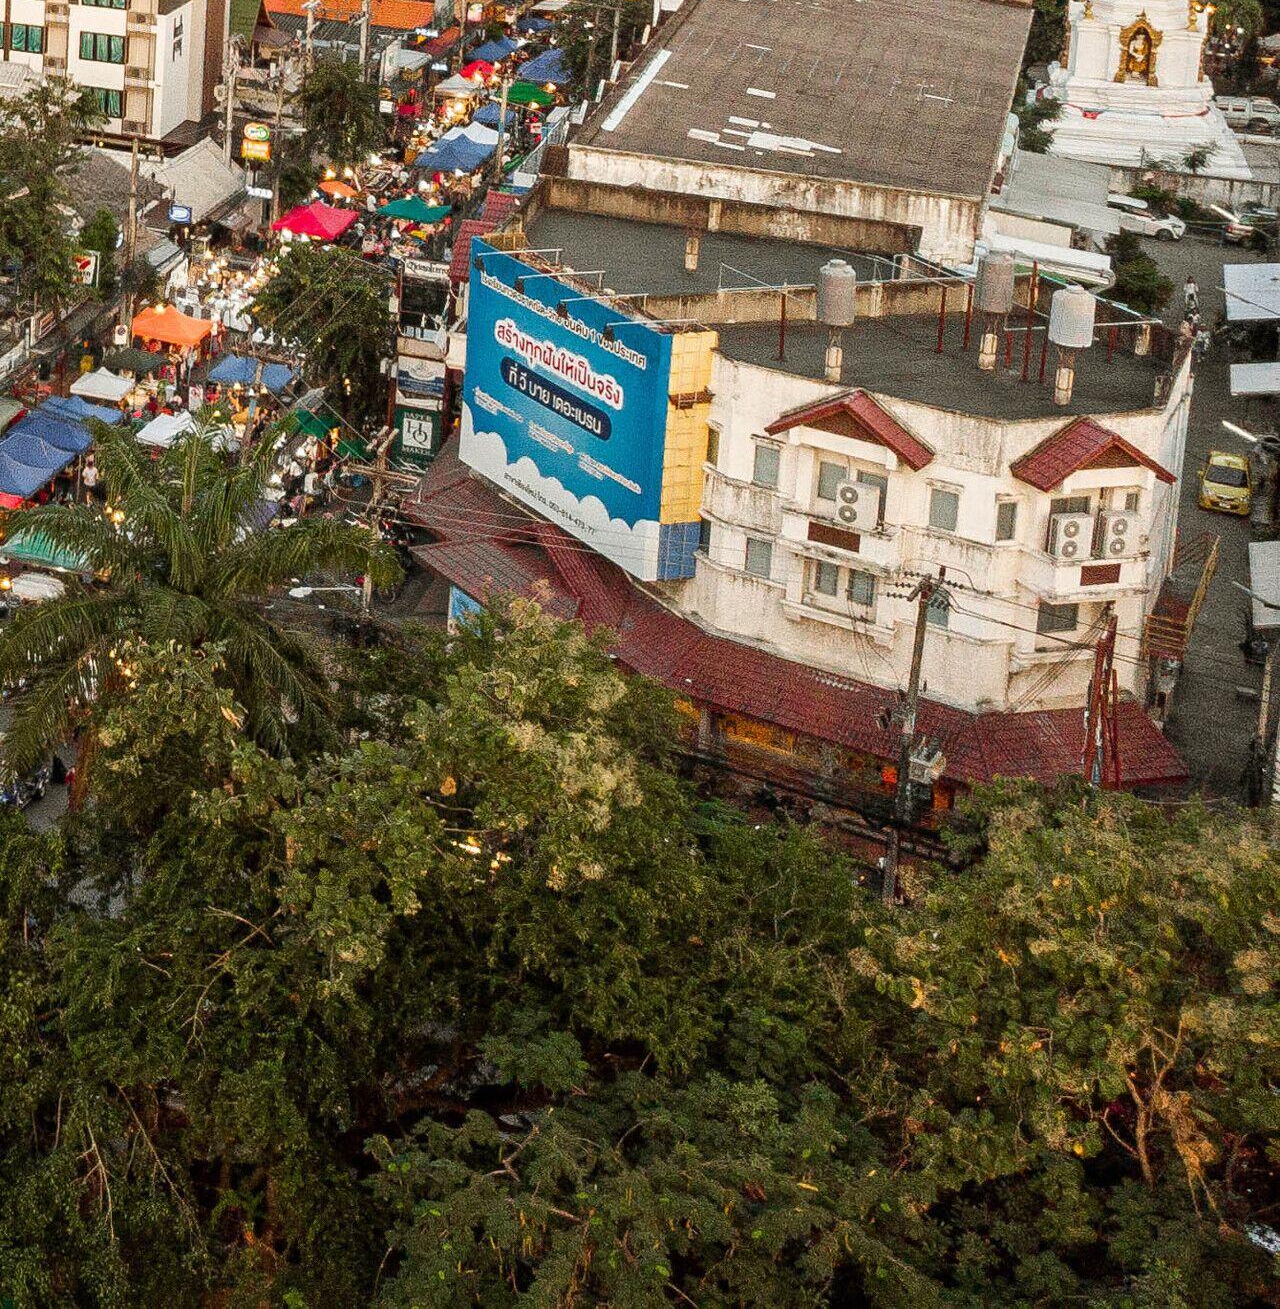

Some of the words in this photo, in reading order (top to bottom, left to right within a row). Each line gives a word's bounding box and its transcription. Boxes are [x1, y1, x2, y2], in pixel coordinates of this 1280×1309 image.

[496, 323, 621, 405] สร้างทุกฝันให้เป็นจริง
[589, 327, 595, 343] 1
[508, 362, 518, 387] ที่
[519, 371, 526, 391] วี
[529, 382, 549, 406] บาย
[552, 393, 602, 434] เดอะเบรน
